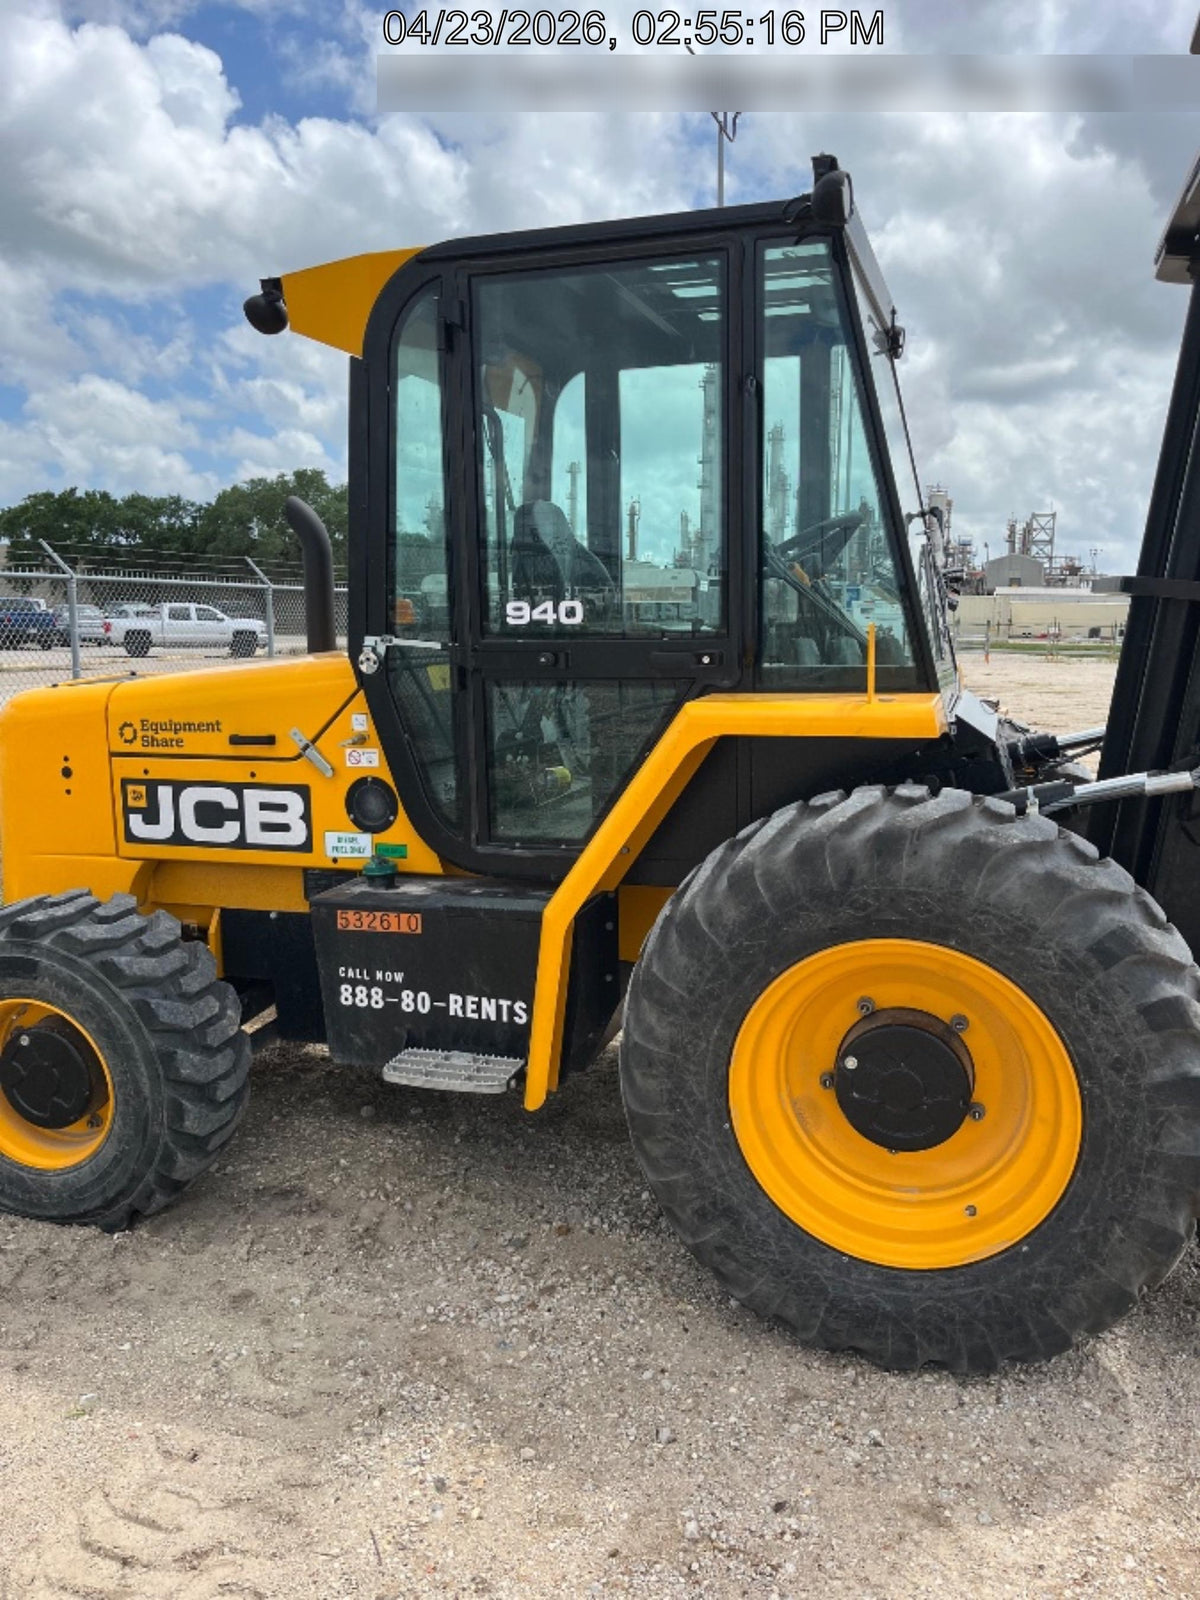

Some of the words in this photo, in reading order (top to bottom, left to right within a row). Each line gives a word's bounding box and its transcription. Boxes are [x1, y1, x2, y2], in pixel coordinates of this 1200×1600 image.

[506, 600, 584, 625] 940
[140, 719, 222, 735] Equipment
[141, 735, 184, 748] Share
[128, 785, 309, 846] JCB
[338, 911, 419, 932] 532610
[338, 966, 371, 980] CALL
[375, 970, 405, 983] NOW
[339, 984, 528, 1024] 888-80-RENTS
